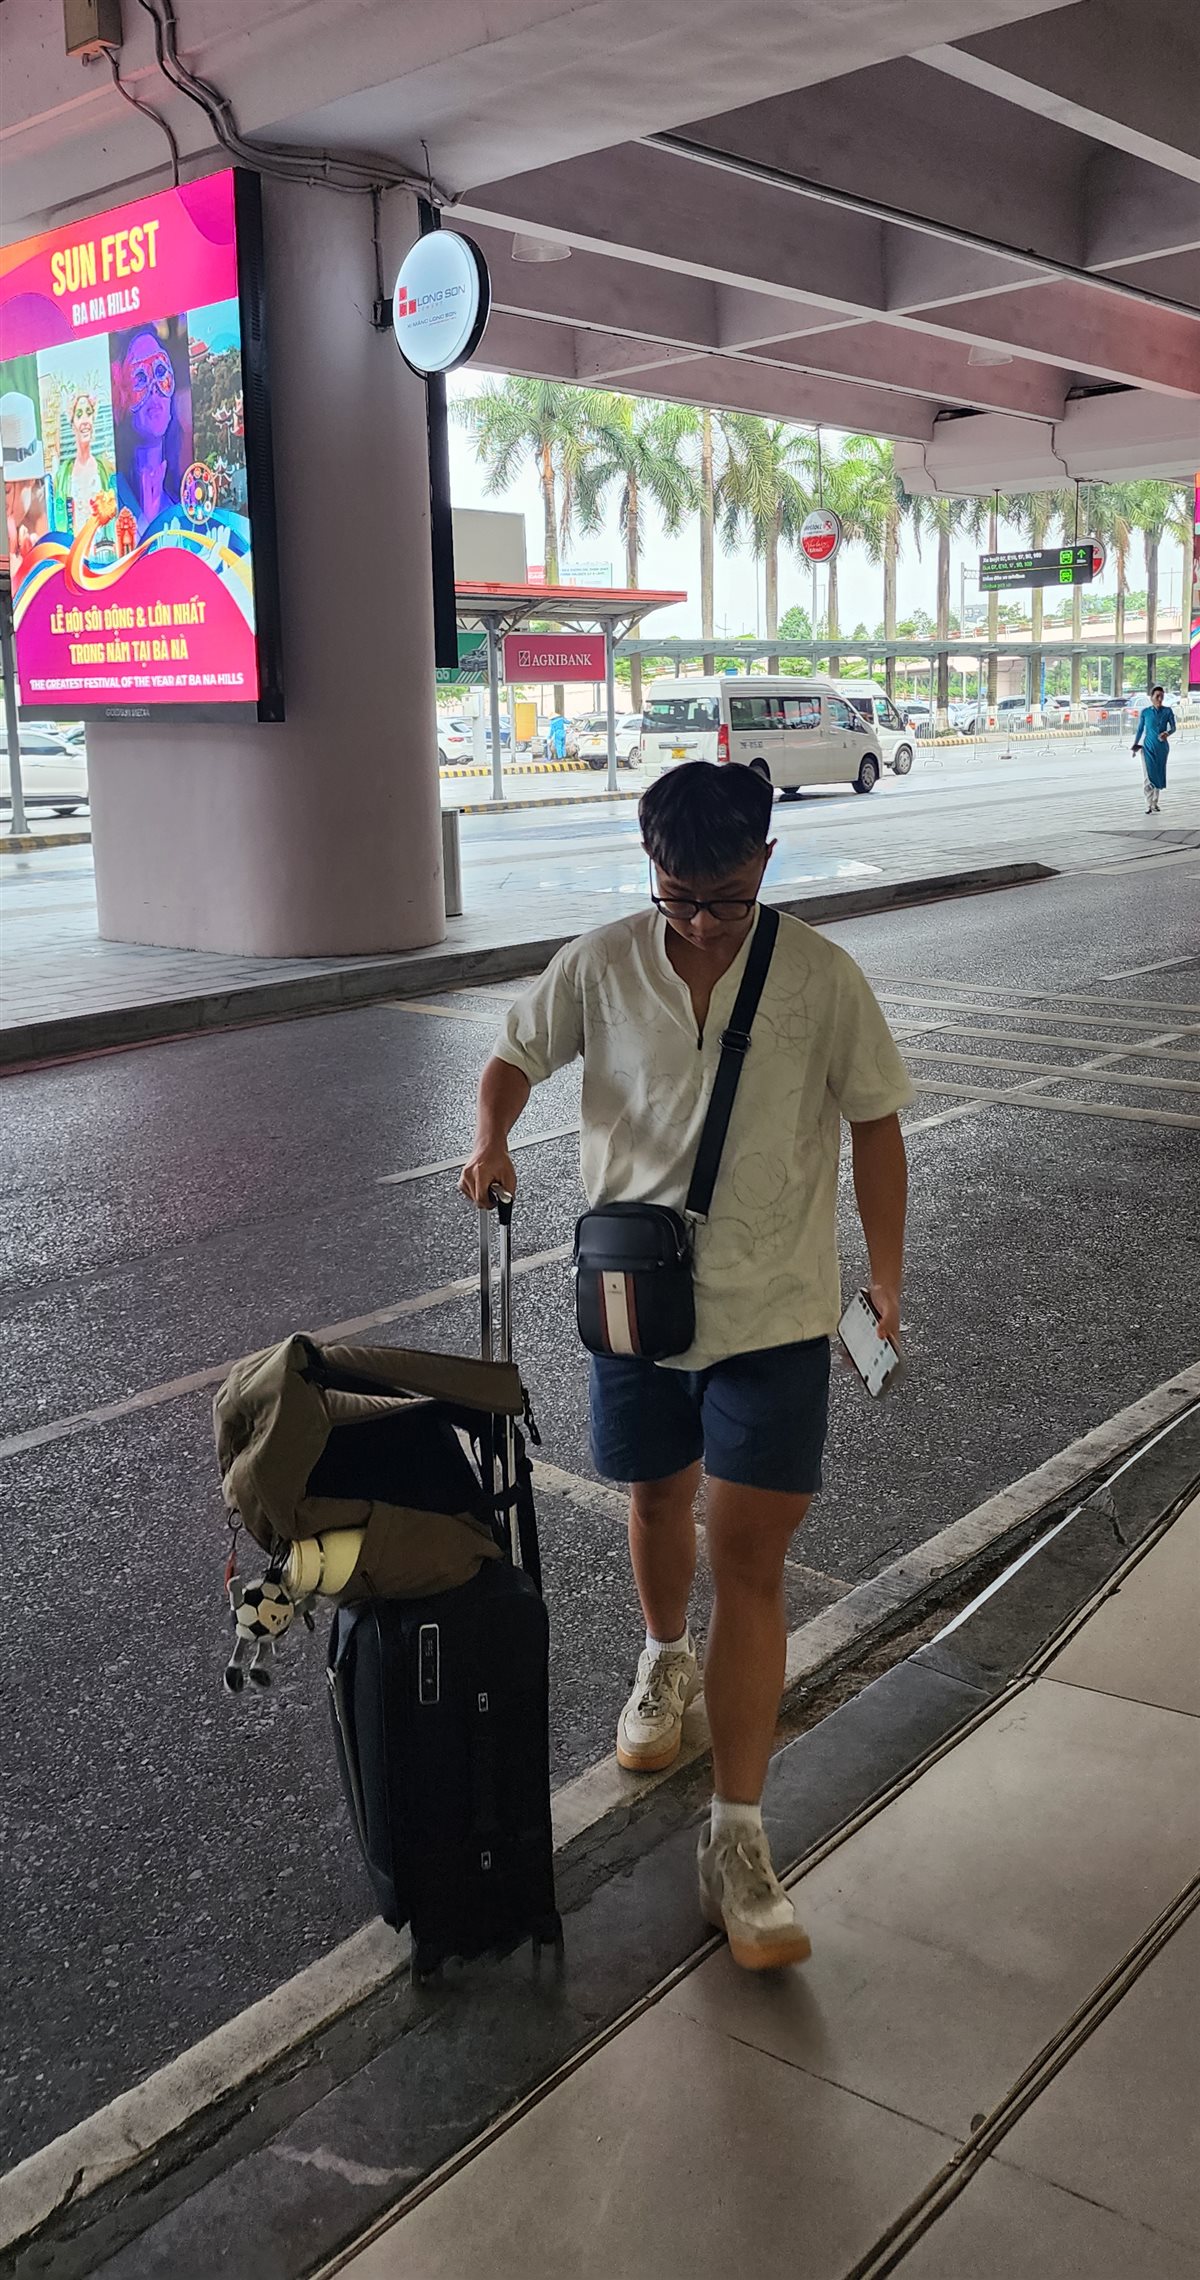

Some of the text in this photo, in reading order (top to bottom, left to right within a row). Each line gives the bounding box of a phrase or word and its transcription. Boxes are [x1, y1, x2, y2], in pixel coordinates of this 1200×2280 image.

[51, 219, 159, 296] SUN FEST
[72, 286, 140, 326] BA NA HILLS
[417, 291, 443, 306] LONG
[50, 594, 206, 638] LỄ HỘI SÔI ĐỘNG & LỚN NHẤT
[69, 643, 105, 665] TRONG
[131, 640, 151, 668] TẠI
[152, 634, 170, 661] BÀ
[170, 633, 189, 660] NÀ
[532, 654, 592, 666] AGRIBANK
[30, 672, 244, 691] THE GREATEST FESTIVAL OF THE YEAR AT BA NA HILLS
